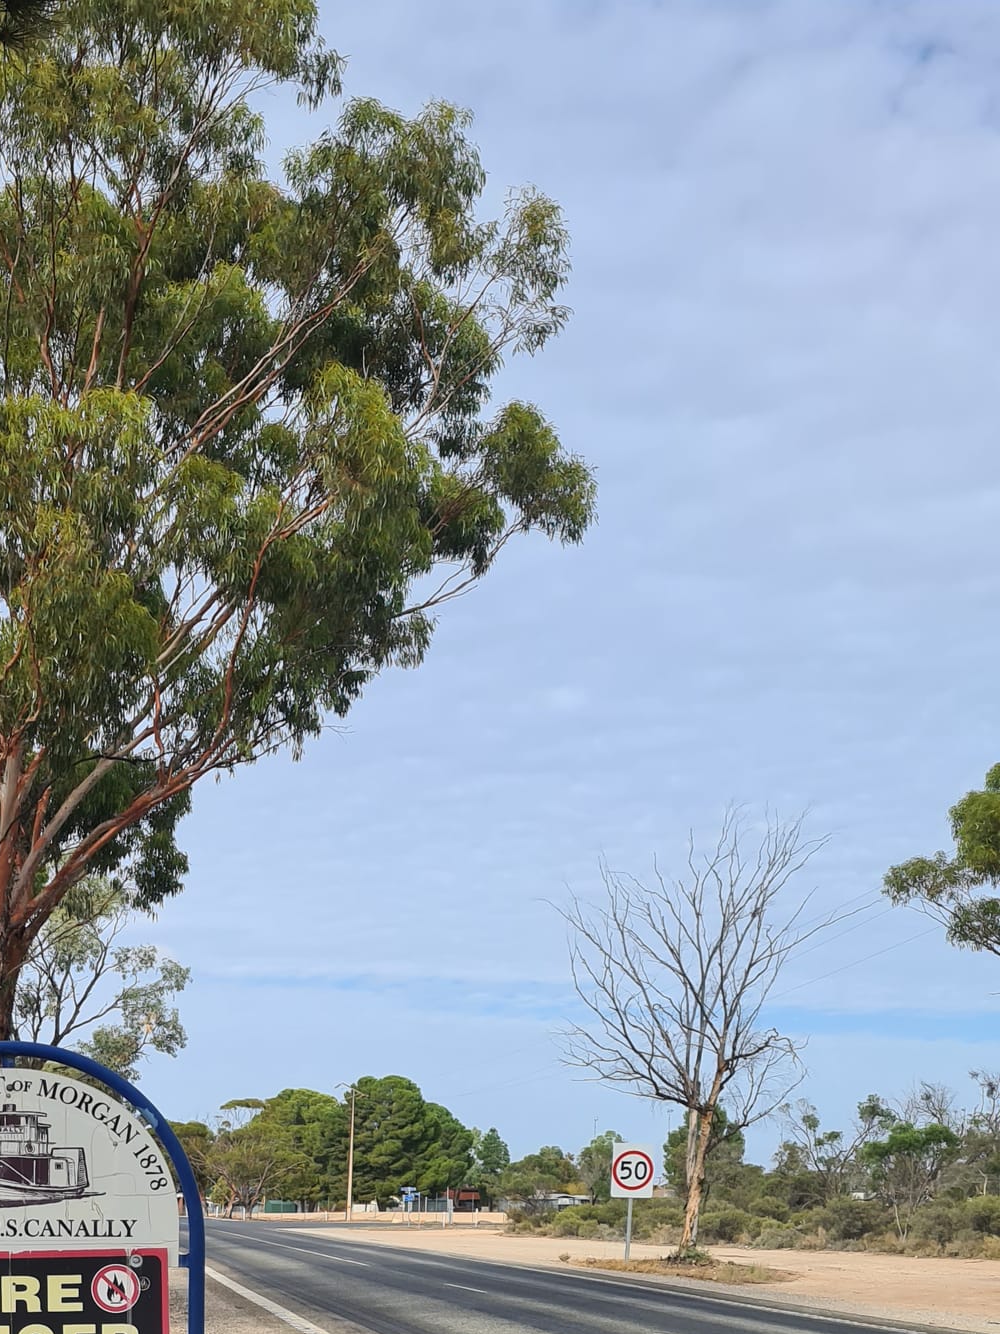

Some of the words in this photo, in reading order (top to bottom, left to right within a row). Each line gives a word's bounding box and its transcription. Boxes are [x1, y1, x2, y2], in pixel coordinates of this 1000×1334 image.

[12, 1080, 32, 1092] OF
[36, 1078, 141, 1145] MORGAN
[132, 1143, 168, 1191] 1878
[620, 1161, 648, 1180] 50
